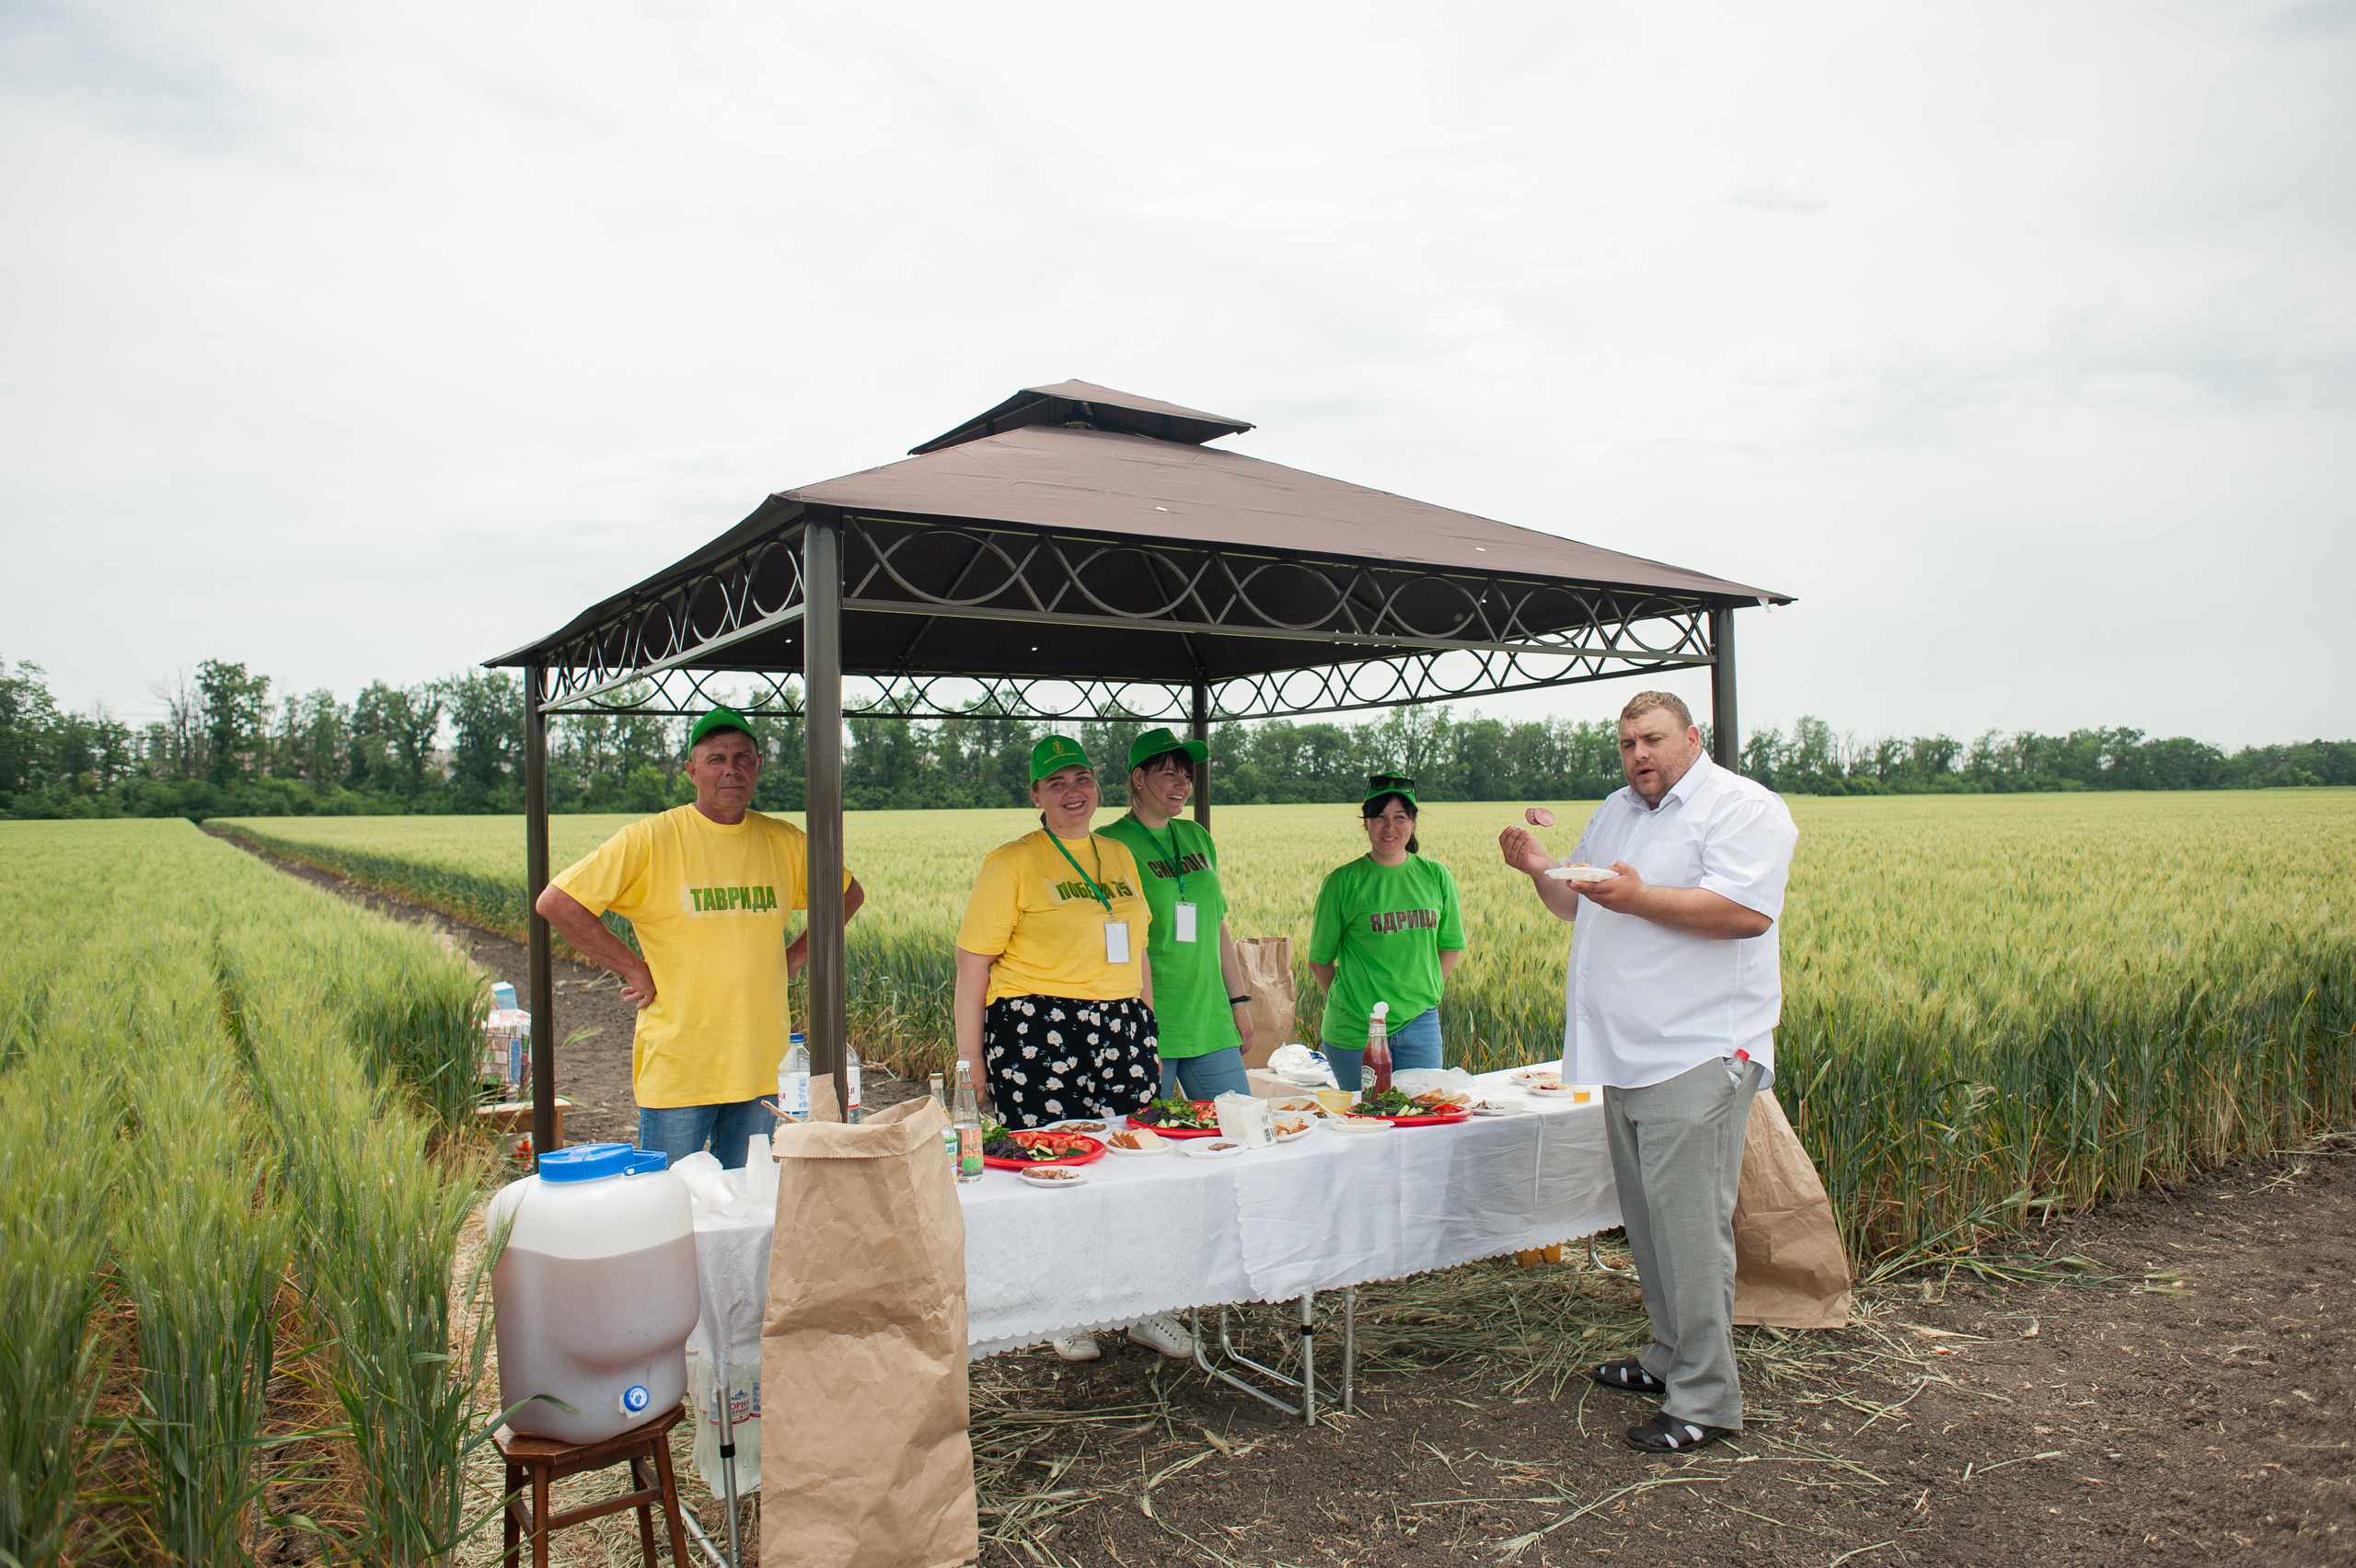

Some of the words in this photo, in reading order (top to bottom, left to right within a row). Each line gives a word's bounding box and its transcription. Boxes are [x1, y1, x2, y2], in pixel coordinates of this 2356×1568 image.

[689, 886, 778, 913] ТАВРИДА
[1056, 881, 1116, 903] ПОБЕА
[1111, 881, 1133, 897] 75
[1369, 909, 1437, 934] ЯДРИЦА
